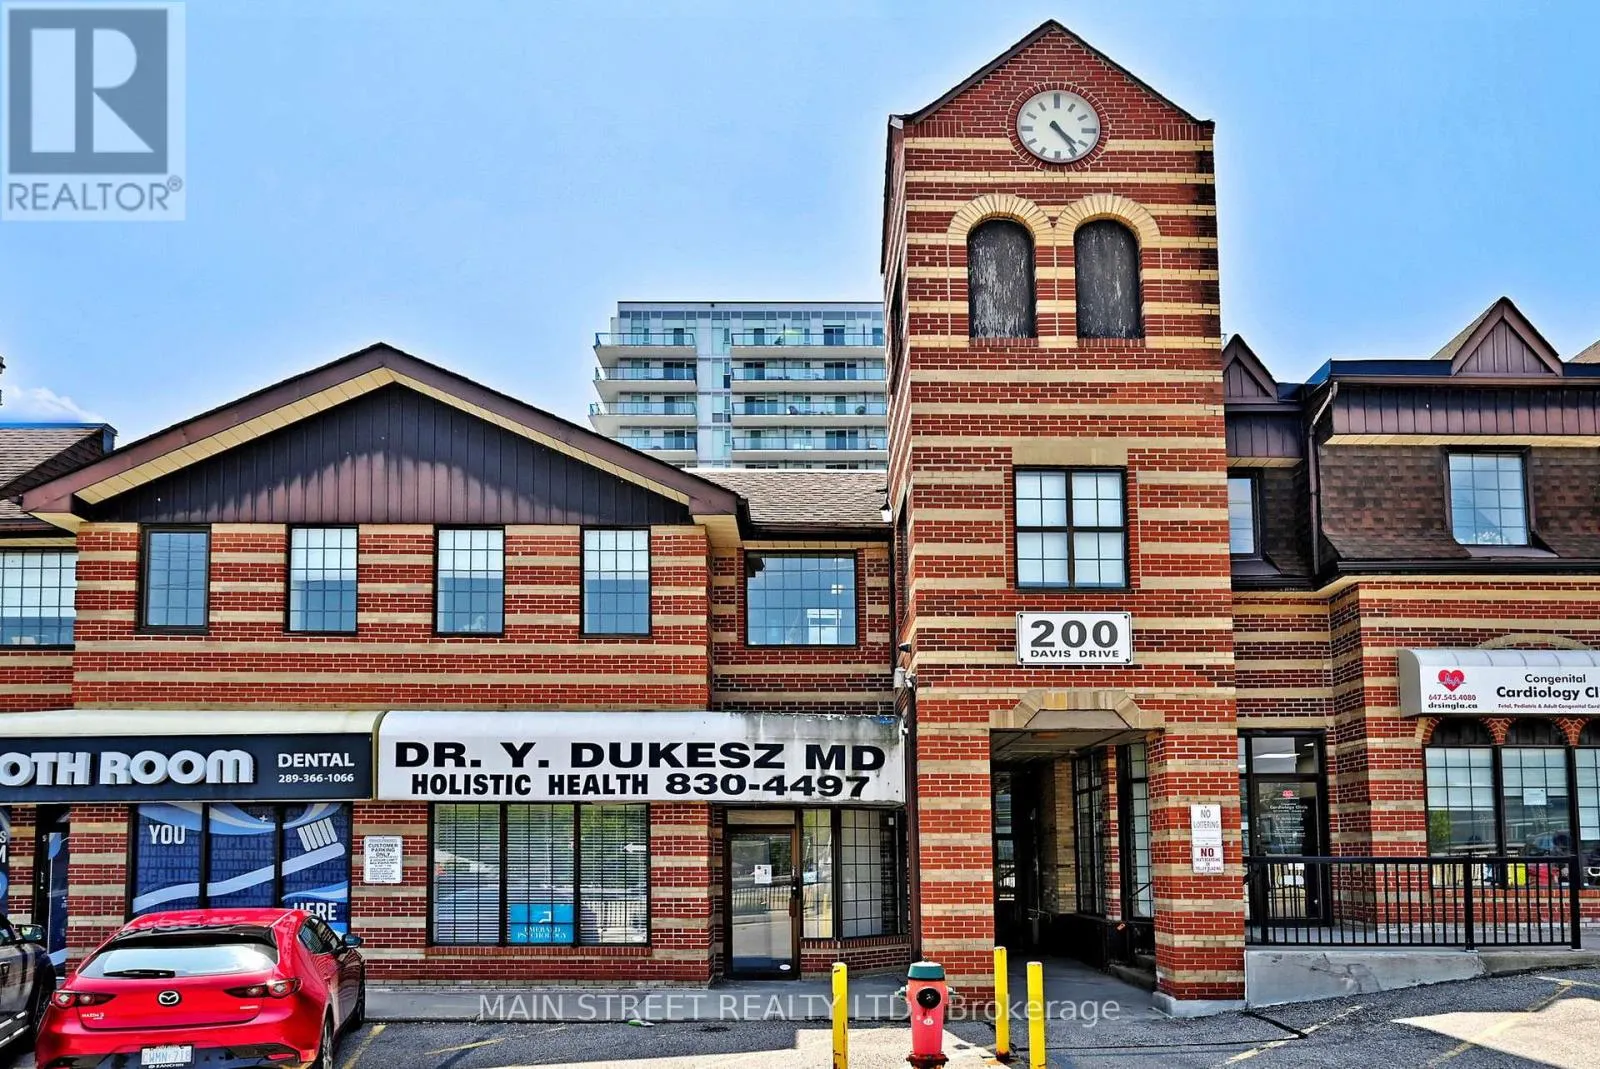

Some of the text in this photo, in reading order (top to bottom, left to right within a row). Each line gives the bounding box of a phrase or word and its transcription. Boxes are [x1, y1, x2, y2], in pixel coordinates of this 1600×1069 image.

[1030, 620, 1118, 648] 200
[1030, 650, 1119, 658] DAVIS DRIVE
[1524, 673, 1586, 684] Congenital
[1496, 686, 1580, 701] Cardiology
[278, 752, 354, 768] DENTAL
[395, 742, 886, 771] DR. Y. DUKESZ MD
[99, 750, 254, 786] ROOM
[278, 773, 354, 783] 289-366-1066
[412, 773, 870, 797] HOLISTIC HEALTH 830-4497
[1201, 809, 1211, 818] NO
[149, 824, 186, 845] YOU
[1200, 847, 1215, 857] NO
